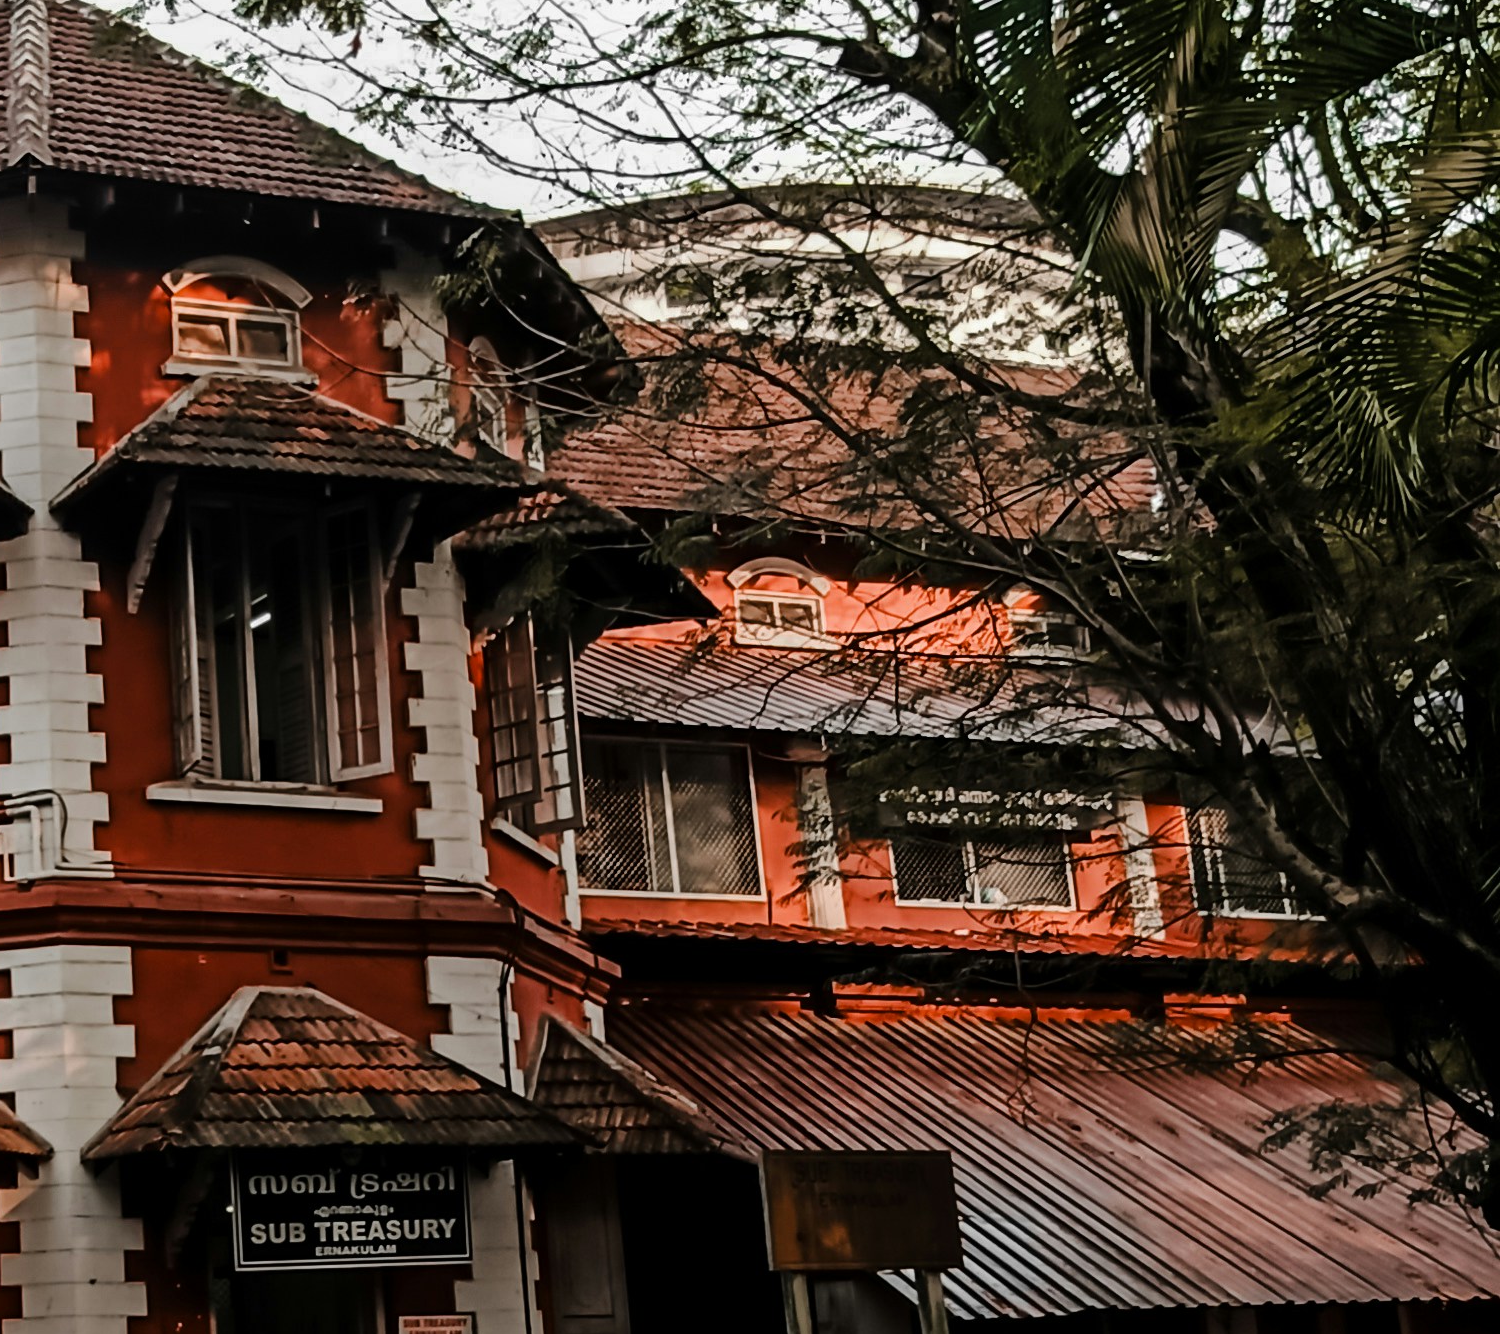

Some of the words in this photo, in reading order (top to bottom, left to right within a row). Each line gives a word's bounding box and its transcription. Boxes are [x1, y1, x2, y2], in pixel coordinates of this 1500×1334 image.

[248, 1167, 341, 1195] സബ്
[349, 1165, 456, 1200] ട്രഷറി
[793, 1162, 830, 1184] SUB
[250, 1222, 306, 1245] SUB
[313, 1218, 457, 1243] TREASURY
[315, 1244, 397, 1257] ERNAKULAM
